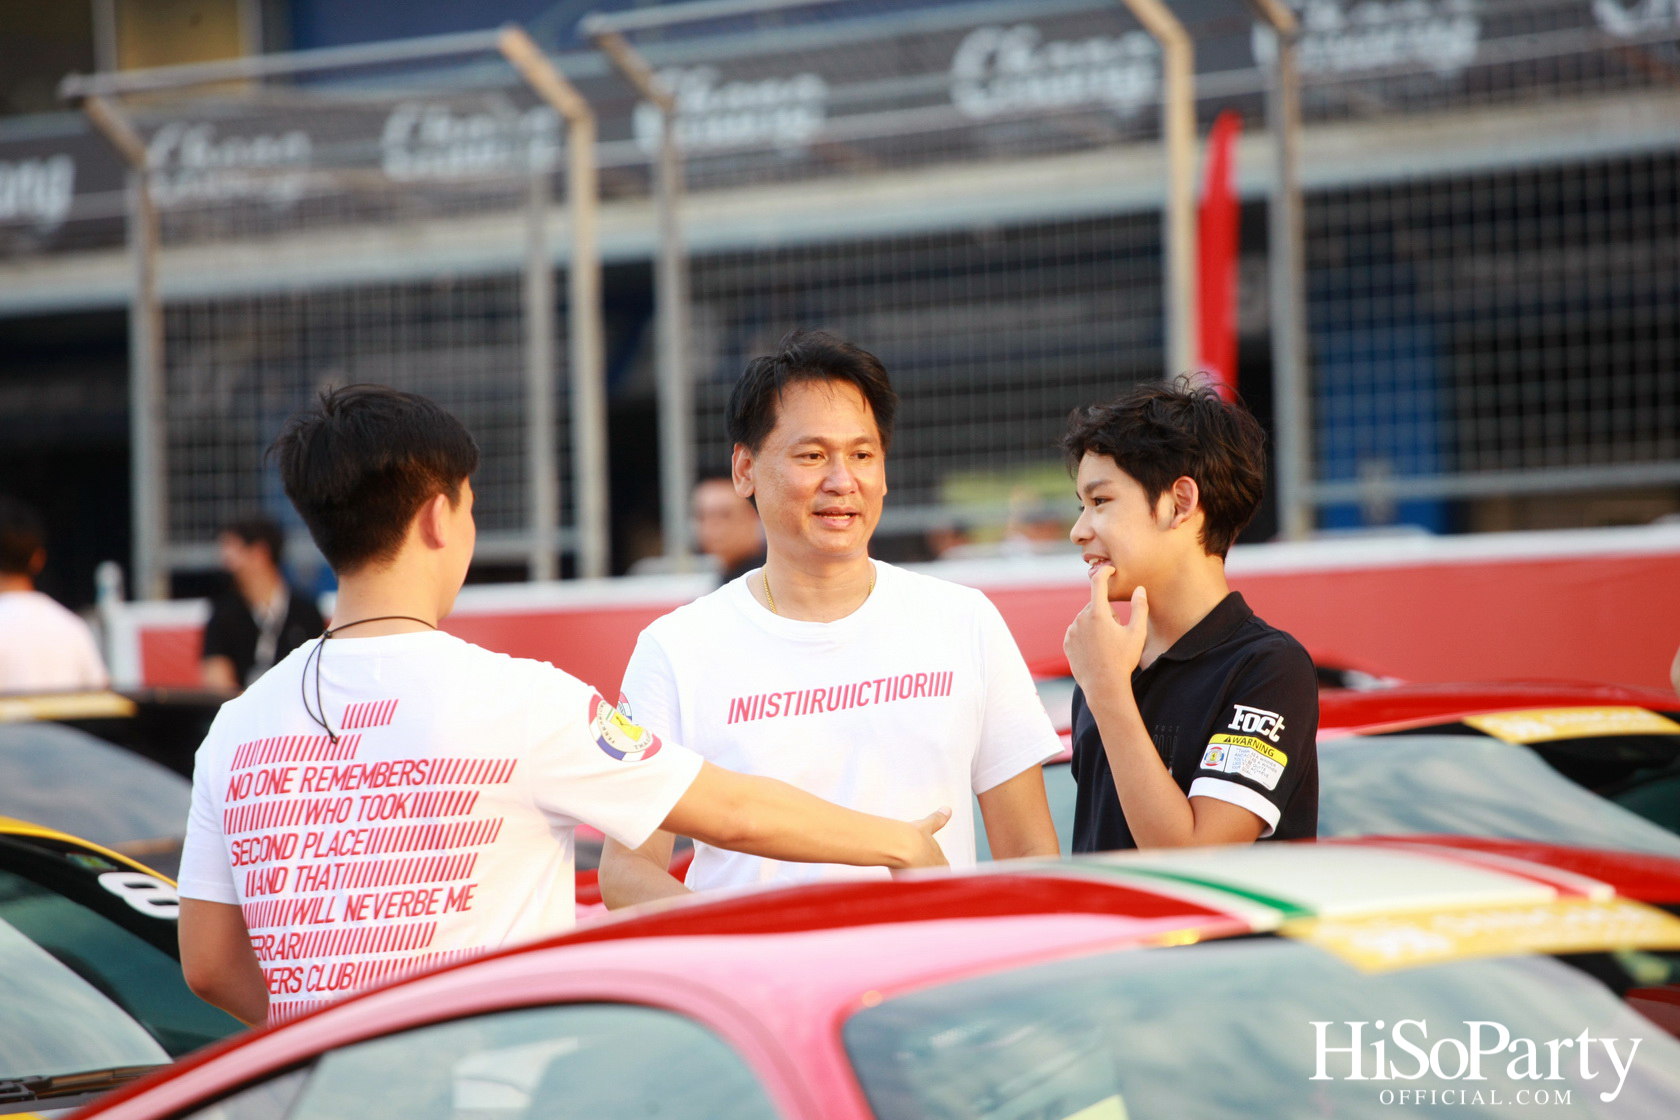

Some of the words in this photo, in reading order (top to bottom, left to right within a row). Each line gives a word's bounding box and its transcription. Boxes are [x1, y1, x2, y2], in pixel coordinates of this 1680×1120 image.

[1232, 736, 1275, 758] WARNING
[226, 772, 254, 803] NO
[254, 767, 299, 797] ONE
[299, 758, 430, 793] REMEMBERS
[304, 796, 354, 826] WHO
[357, 792, 414, 823] TOOK
[231, 832, 300, 867] SECOND
[300, 828, 370, 860] PLACE
[294, 862, 346, 893] THAT
[291, 895, 337, 926] WILL
[442, 883, 478, 914] ME
[306, 962, 356, 993] CLUB
